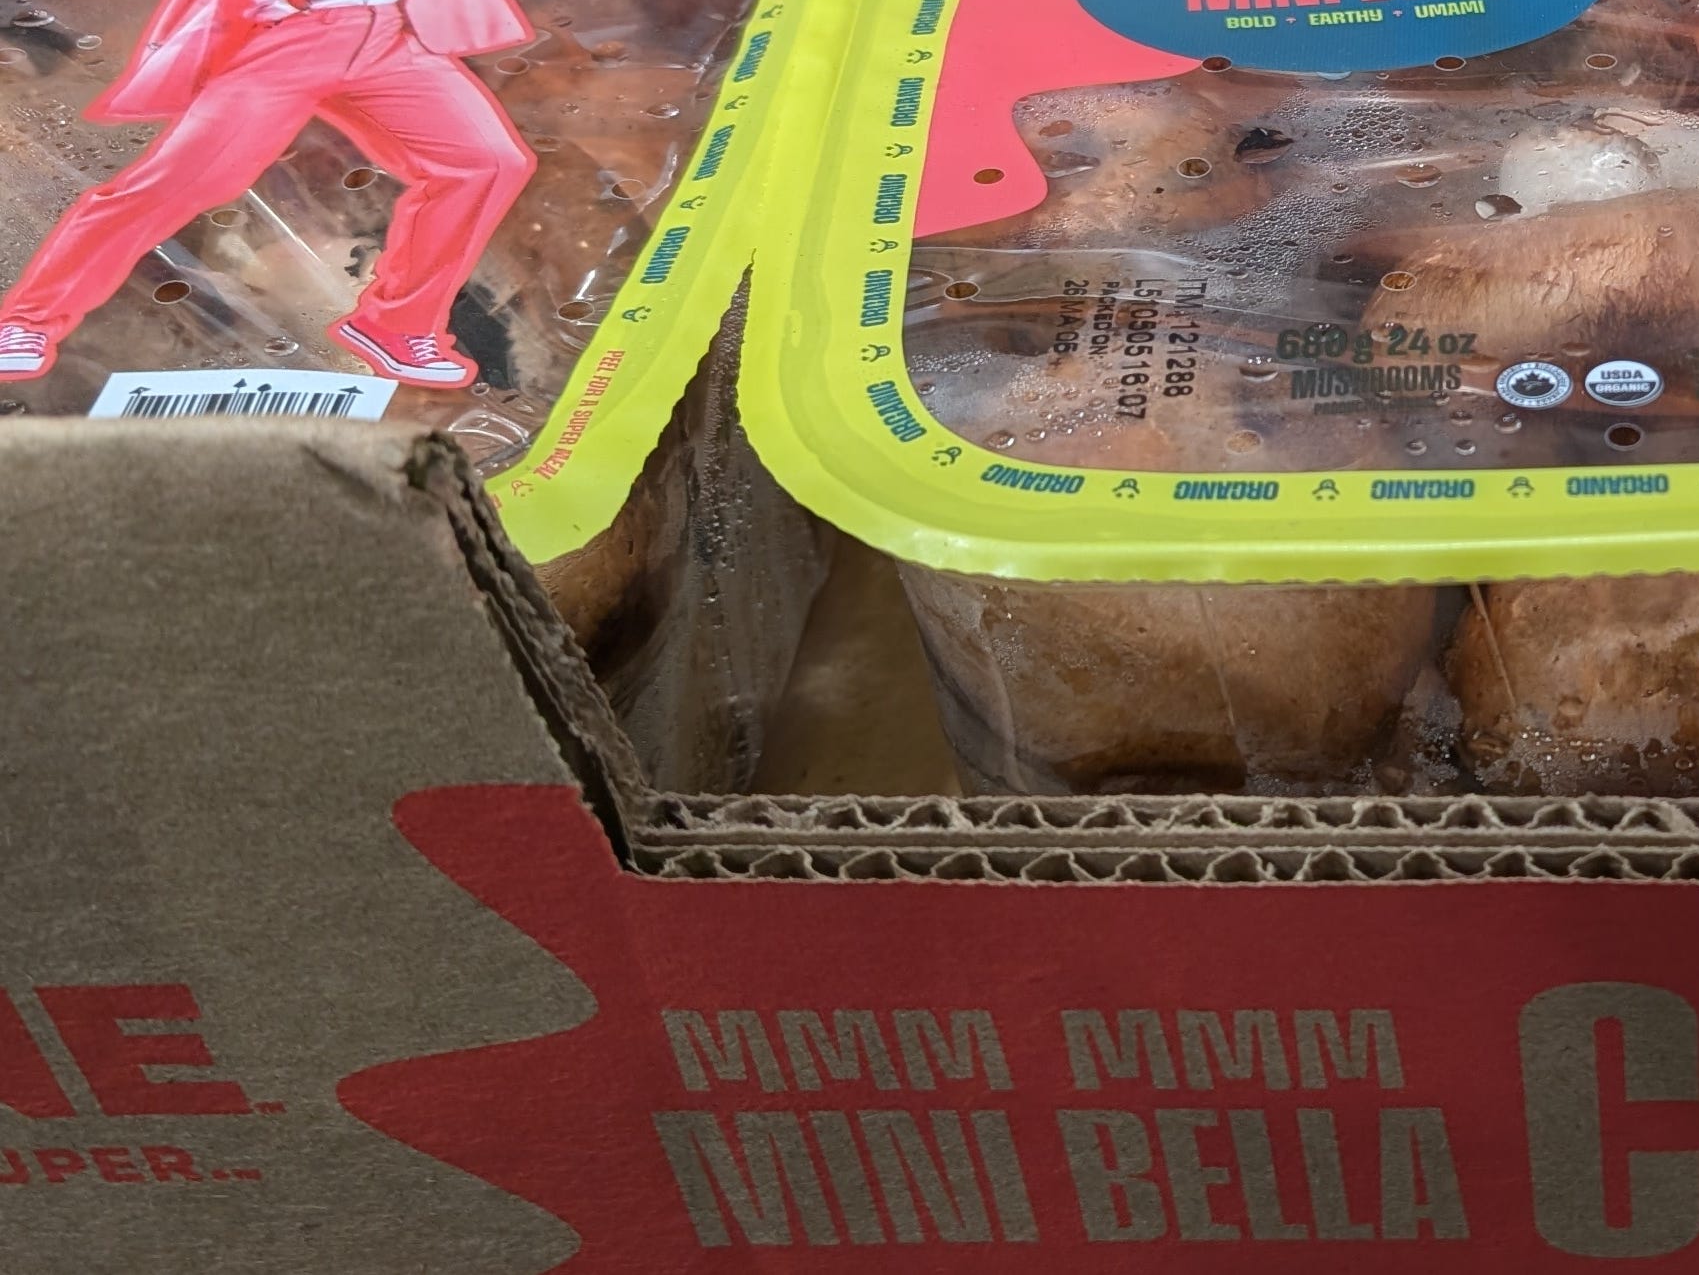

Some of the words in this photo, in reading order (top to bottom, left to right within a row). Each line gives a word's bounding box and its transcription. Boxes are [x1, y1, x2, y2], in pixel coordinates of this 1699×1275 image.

[1226, 15, 1276, 29] BOLD
[1309, 9, 1383, 26] EARTHY
[1414, 0, 1486, 19] UMAMI
[860, 269, 893, 327] ORGANIC
[1063, 280, 1089, 295] 26
[1057, 301, 1085, 326] MA
[1094, 281, 1120, 330] PACKED
[1124, 279, 1168, 356] L510505
[1163, 321, 1200, 397] 121288
[1275, 324, 1348, 359] 680
[1352, 329, 1374, 364] g
[1388, 325, 1430, 356] 24
[1438, 332, 1478, 354] oz
[599, 350, 625, 372] PEEL
[1601, 369, 1644, 380] USDA
[589, 375, 611, 398] FOR
[1116, 360, 1151, 418] 16:07
[1290, 363, 1462, 400] MUSHROOMS
[1595, 382, 1650, 393] ORGANIC
[557, 409, 593, 446] SUPER
[866, 380, 927, 443] ORGANIC
[532, 447, 573, 480] MEAL
[981, 463, 1085, 495] ORGANIC
[1174, 480, 1280, 501] ORGANIC
[1370, 478, 1475, 500] ORGANIC
[1566, 473, 1669, 495] ORGANIC
[661, 1008, 1014, 1094] MMM
[1061, 1008, 1405, 1092] MMM
[652, 1108, 1040, 1248] MINI
[1055, 1106, 1472, 1243] BELLA
